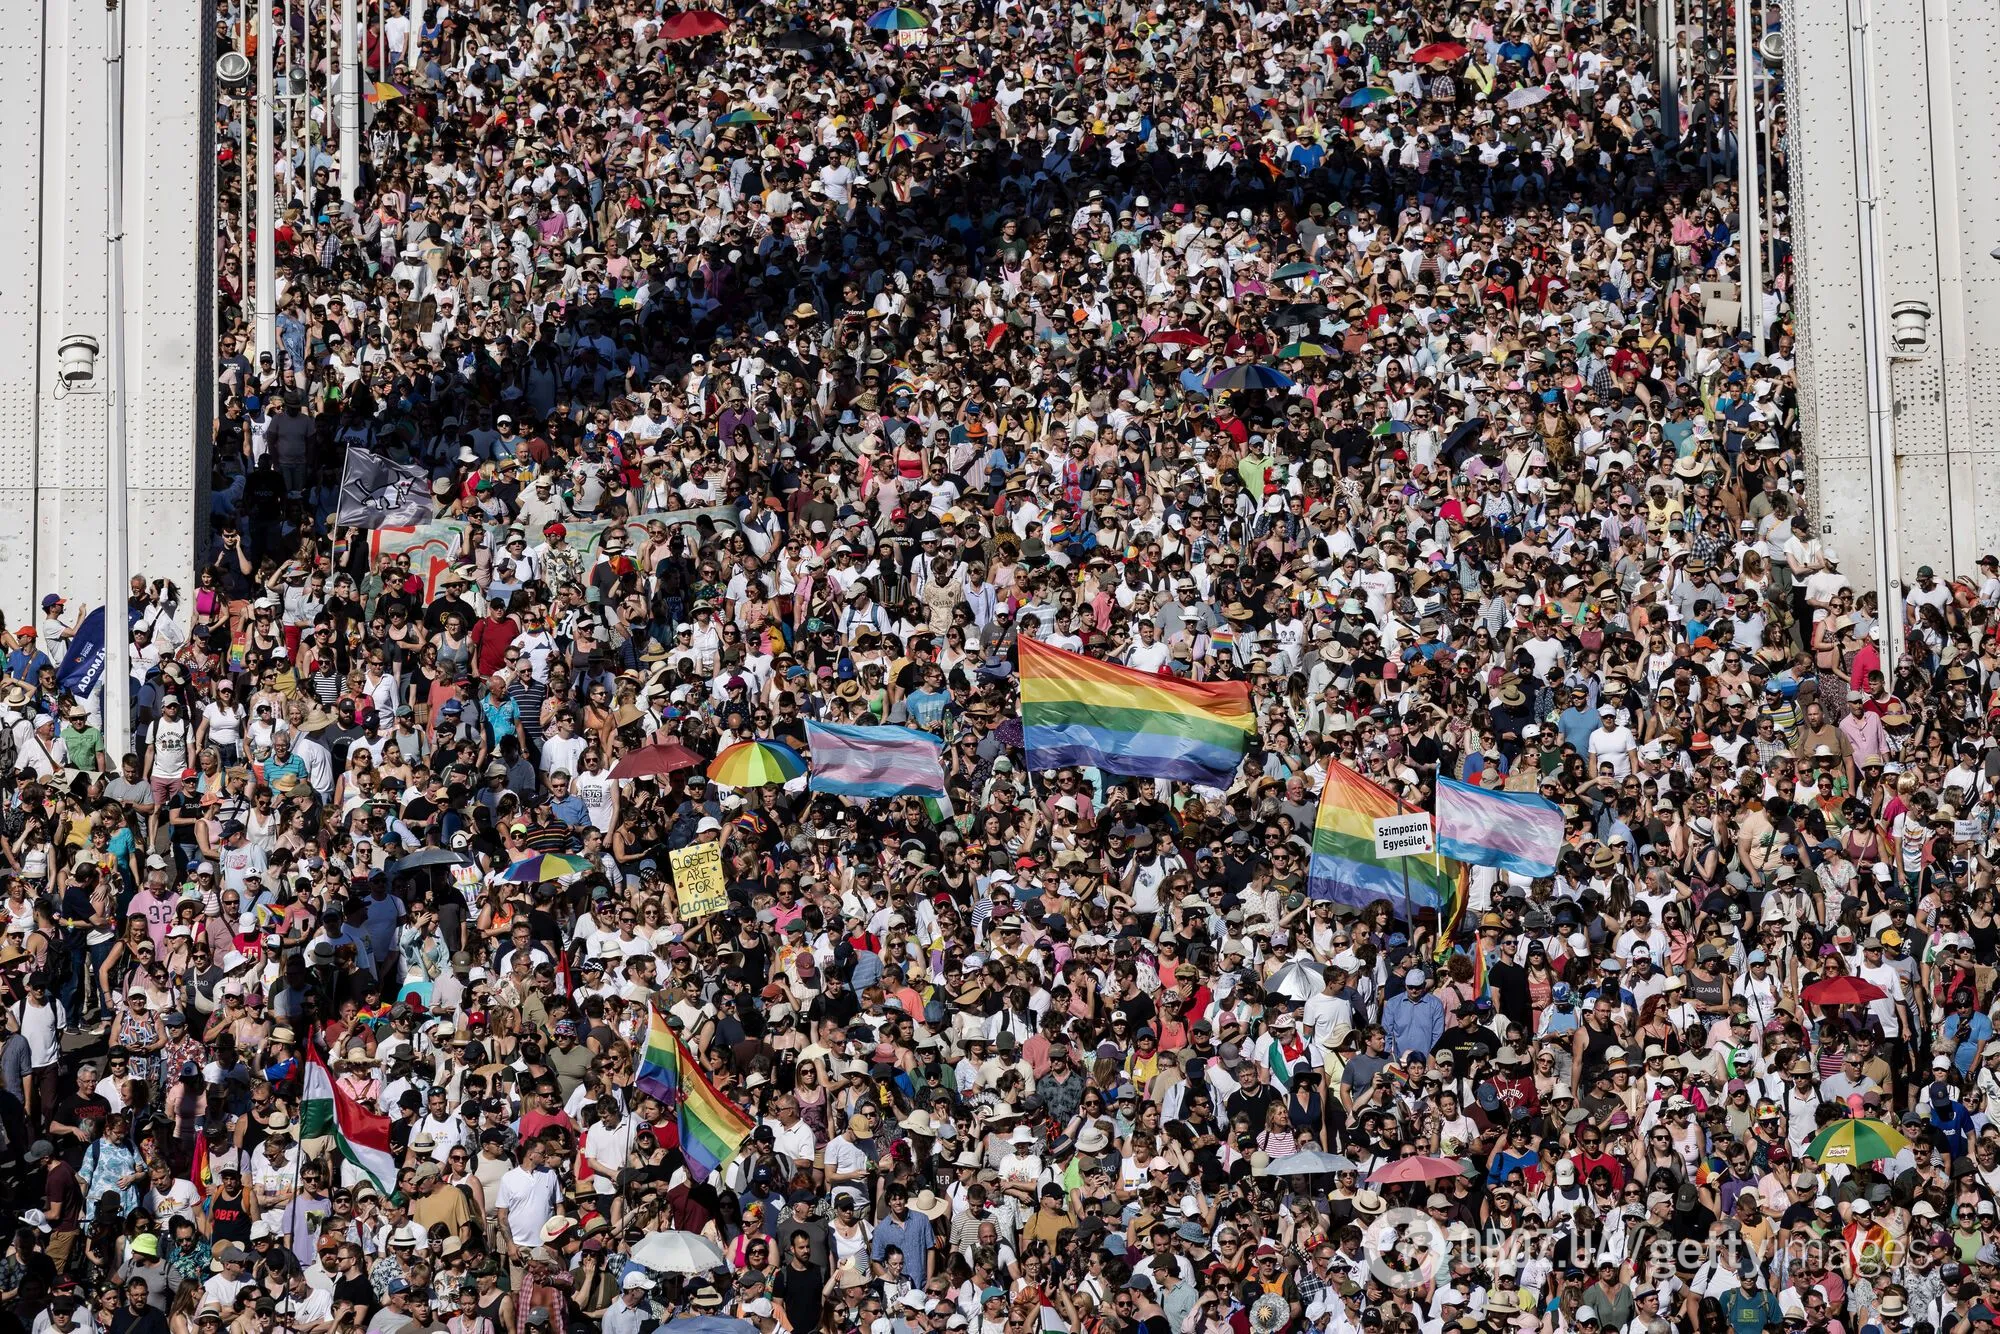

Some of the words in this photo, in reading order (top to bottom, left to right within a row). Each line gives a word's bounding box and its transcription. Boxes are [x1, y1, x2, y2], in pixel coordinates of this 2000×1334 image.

[78, 647, 105, 693] ADOMÁ
[583, 790, 602, 798] 1976
[1378, 822, 1428, 838] Szimpozion
[1383, 835, 1426, 852] Egyesület
[672, 849, 720, 871] CLOSETS
[686, 868, 710, 881] ARE
[688, 881, 714, 895] FOR
[680, 896, 728, 916] CLOTHES
[1497, 1088, 1524, 1100] ANFORD
[214, 1208, 240, 1221] OBEY
